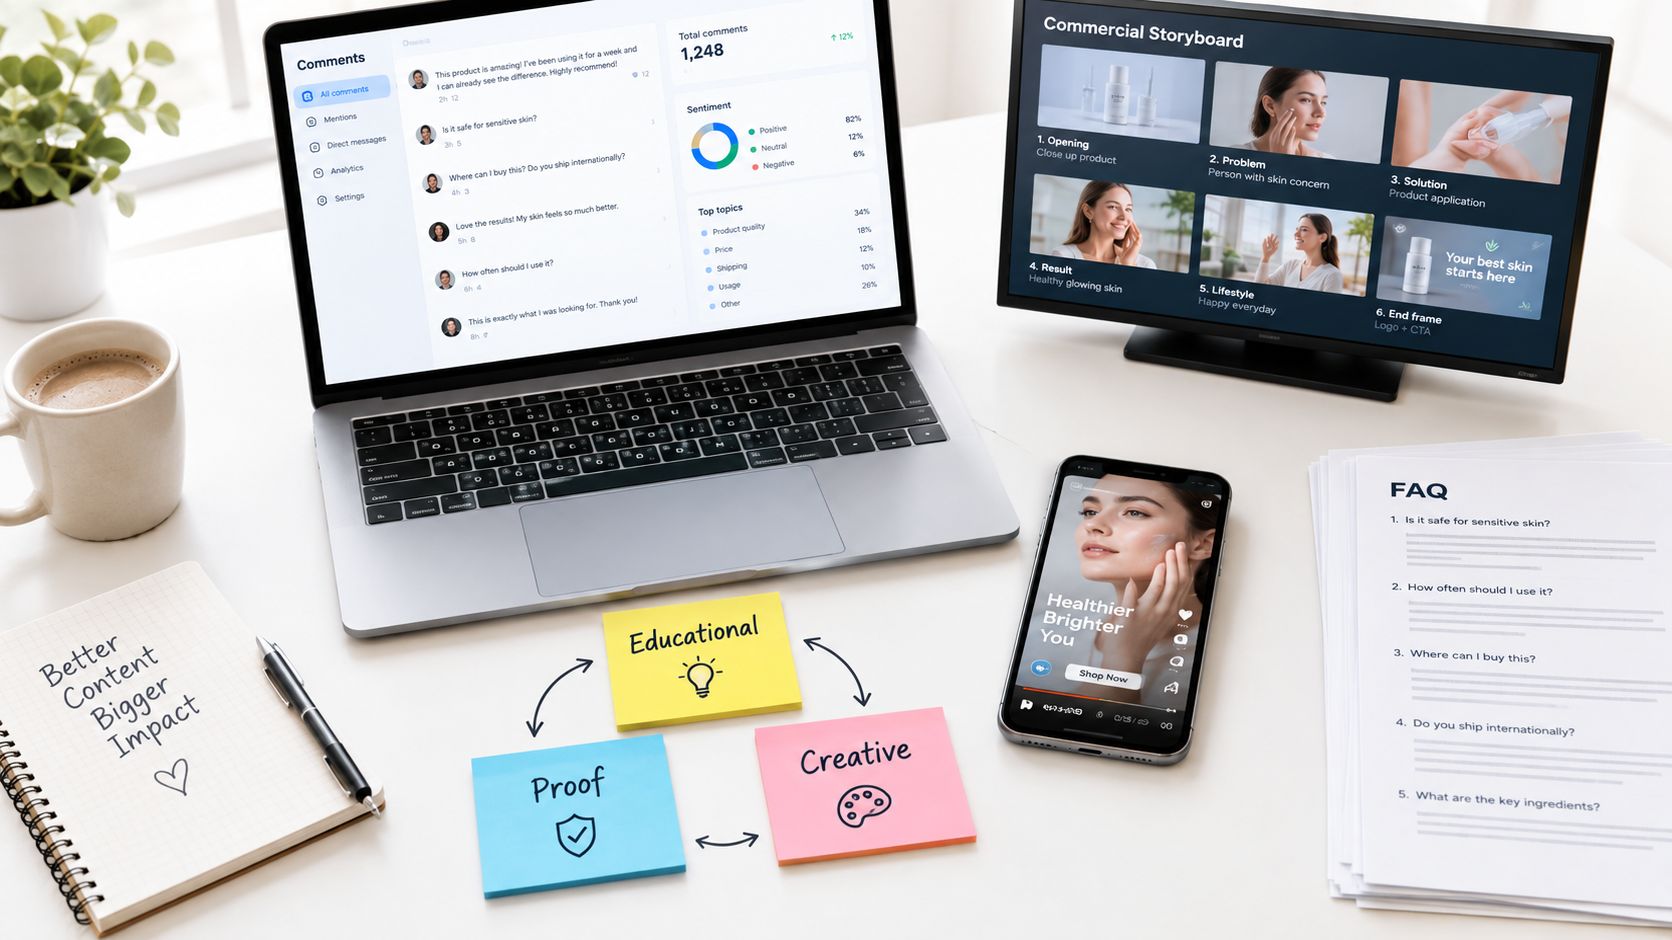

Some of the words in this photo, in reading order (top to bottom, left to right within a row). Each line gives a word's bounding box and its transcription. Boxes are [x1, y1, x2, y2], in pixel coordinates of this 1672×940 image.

[678, 30, 700, 40] Total
[702, 25, 748, 37] comments
[839, 31, 853, 40] 12%
[1043, 16, 1144, 39] Commercial
[1148, 26, 1244, 48] Storyboard
[680, 42, 724, 62] 1,248
[297, 53, 365, 71] Comments
[451, 67, 481, 78] product
[489, 61, 522, 72] amazing!
[537, 57, 556, 65] been
[557, 55, 577, 63] using
[602, 47, 622, 56] week
[623, 45, 637, 54] and
[455, 78, 481, 88] already
[482, 77, 496, 85] see
[510, 71, 548, 81] difference.
[549, 67, 572, 76] Highly
[573, 60, 617, 72] recommend!
[320, 90, 330, 98] All
[331, 86, 369, 97] comments
[686, 101, 731, 114] Sentiment
[323, 113, 357, 123] Mentions
[456, 123, 472, 132] safe
[485, 118, 517, 128] sensitive
[518, 114, 537, 124] skin?
[845, 115, 862, 123] 82%
[759, 125, 787, 134] Positive
[848, 132, 863, 140] 12%
[327, 140, 349, 149] Direct
[350, 136, 387, 145] messages
[761, 142, 787, 151] Neutral
[1037, 134, 1044, 143] 1.
[1047, 136, 1089, 151] Opening
[1036, 147, 1063, 159] Close
[1065, 152, 1077, 161] up
[1079, 154, 1117, 164] product
[1209, 154, 1219, 164] 2.
[1222, 155, 1266, 169] Problem
[330, 164, 364, 175] Analytics
[448, 173, 473, 182] Where
[474, 171, 488, 179] can
[508, 165, 526, 174] this?
[539, 163, 553, 172] you
[554, 160, 570, 168] ship
[571, 152, 625, 166] internationally?
[762, 159, 795, 170] Negative
[1208, 167, 1242, 179] Person
[1244, 172, 1265, 182] with
[1267, 174, 1287, 184] skin
[1289, 178, 1329, 189] concern
[1390, 174, 1400, 184] 3.
[1404, 176, 1447, 190] Solution
[334, 193, 365, 202] Settings
[1389, 188, 1428, 201] Product
[1430, 194, 1485, 207] application
[455, 222, 473, 230] Love
[488, 216, 514, 225] results!
[528, 213, 544, 221] skin
[544, 210, 563, 218] feels
[574, 206, 594, 215] much
[595, 203, 618, 212] better.
[697, 207, 714, 216] Top
[716, 204, 743, 214] topics
[854, 208, 870, 216] 34%
[712, 226, 741, 235] Product
[741, 223, 765, 232] quality
[857, 226, 872, 234] 18%
[859, 244, 874, 252] 12%
[479, 267, 499, 275] often
[500, 263, 525, 273] should
[716, 262, 748, 272] Shipping
[861, 263, 876, 271] 10%
[1029, 261, 1038, 270] 4.
[1041, 263, 1072, 275] Result
[1446, 252, 1475, 265] Your
[1477, 256, 1505, 269] best
[1507, 260, 1533, 272] skin
[1446, 267, 1483, 280] starts
[1486, 270, 1516, 283] here
[718, 282, 741, 290] Usage
[1029, 274, 1063, 287] Healthy
[1065, 279, 1102, 292] glowing
[1103, 283, 1122, 293] skin
[1199, 284, 1209, 293] 5.
[1211, 285, 1254, 300] Lifestyle
[492, 313, 518, 322] exactly
[518, 310, 537, 318] what
[558, 304, 585, 313] looking
[598, 298, 621, 307] Thank
[622, 296, 637, 306] you!
[720, 300, 740, 308] Other
[1198, 296, 1230, 310] Happy
[1232, 302, 1276, 316] everyday
[1376, 308, 1385, 317] 6.
[1388, 309, 1409, 320] End
[1411, 311, 1442, 324] frame
[1374, 319, 1399, 332] Logo
[1410, 324, 1431, 335] CTA
[1390, 482, 1447, 501] FAQ
[1390, 515, 1398, 523] 1.
[1405, 516, 1414, 524] Is
[1417, 516, 1424, 524] it
[1427, 516, 1450, 524] safe
[1453, 517, 1468, 525] for
[1471, 518, 1519, 526] sensitive
[1522, 519, 1550, 527] skin?
[1392, 582, 1402, 590] 2.
[1408, 583, 1433, 591] How
[1436, 583, 1466, 592] often
[1469, 585, 1506, 594] should
[1539, 587, 1553, 596] it?
[1047, 593, 1134, 617] Healthier
[1043, 611, 1124, 634] Brighter
[629, 613, 758, 654] Educational
[1042, 630, 1074, 646] You
[39, 636, 117, 687] Better
[1394, 648, 1404, 657] 3.
[1410, 649, 1448, 659] Where
[1452, 652, 1473, 660] can
[1482, 652, 1504, 663] buy
[1508, 654, 1536, 663] this?
[64, 646, 158, 709] Content
[1079, 669, 1104, 681] Shop
[1106, 673, 1128, 683] Now
[90, 678, 167, 730] Bigger
[107, 695, 200, 758] Impact
[1395, 718, 1406, 726] 4.
[1413, 718, 1430, 728] Do
[1433, 722, 1455, 730] you
[1458, 721, 1483, 733] ship
[1486, 722, 1575, 738] internationally?
[800, 741, 911, 774] Creative
[531, 766, 605, 803] Proof
[1398, 789, 1409, 799] 5.
[1415, 791, 1448, 801] What
[1452, 795, 1471, 803] are
[1475, 795, 1495, 804] the
[1499, 796, 1520, 808] key
[1524, 798, 1600, 811] ingredients?
